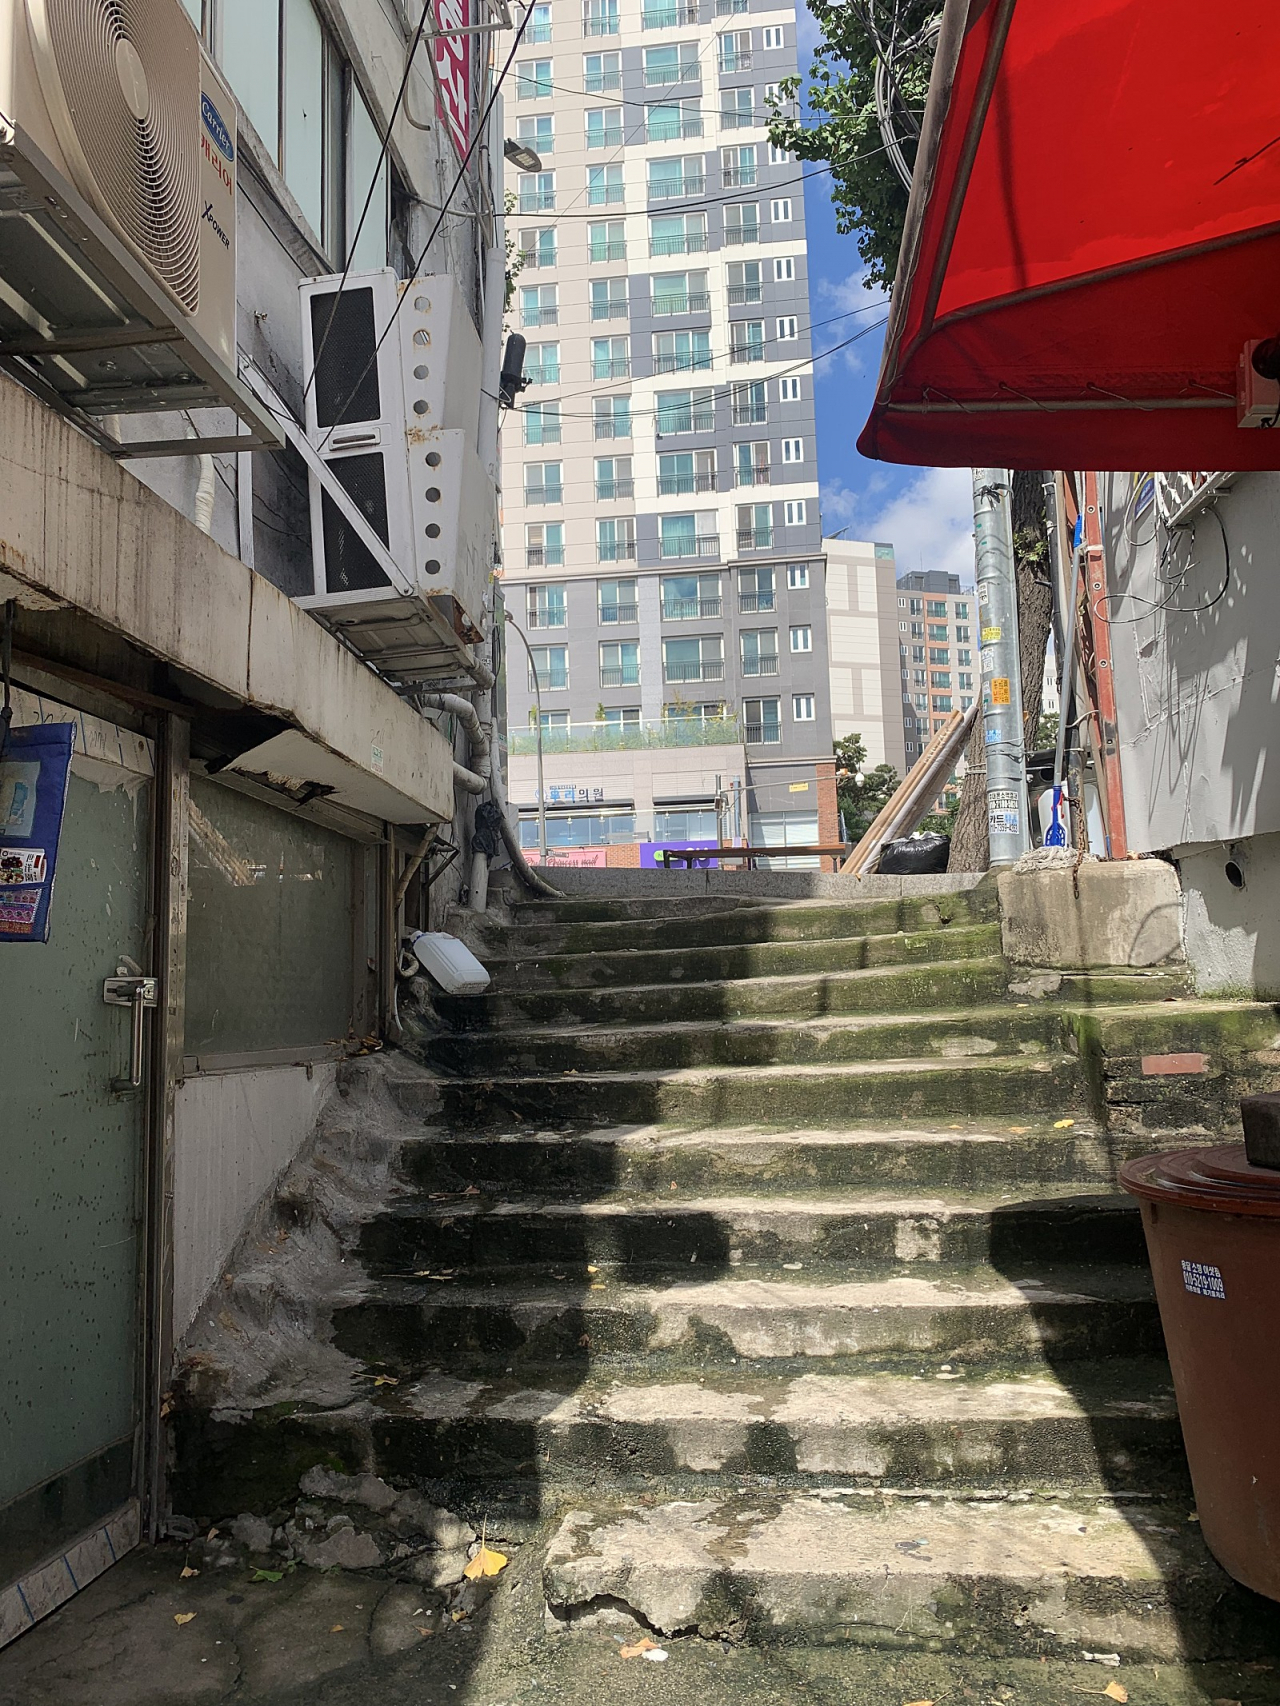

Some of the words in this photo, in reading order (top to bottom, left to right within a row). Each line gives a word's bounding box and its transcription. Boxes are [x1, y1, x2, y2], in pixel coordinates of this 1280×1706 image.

[202, 101, 231, 149] Carrier
[201, 133, 232, 195] 캐리어
[990, 814, 1004, 823] 카드
